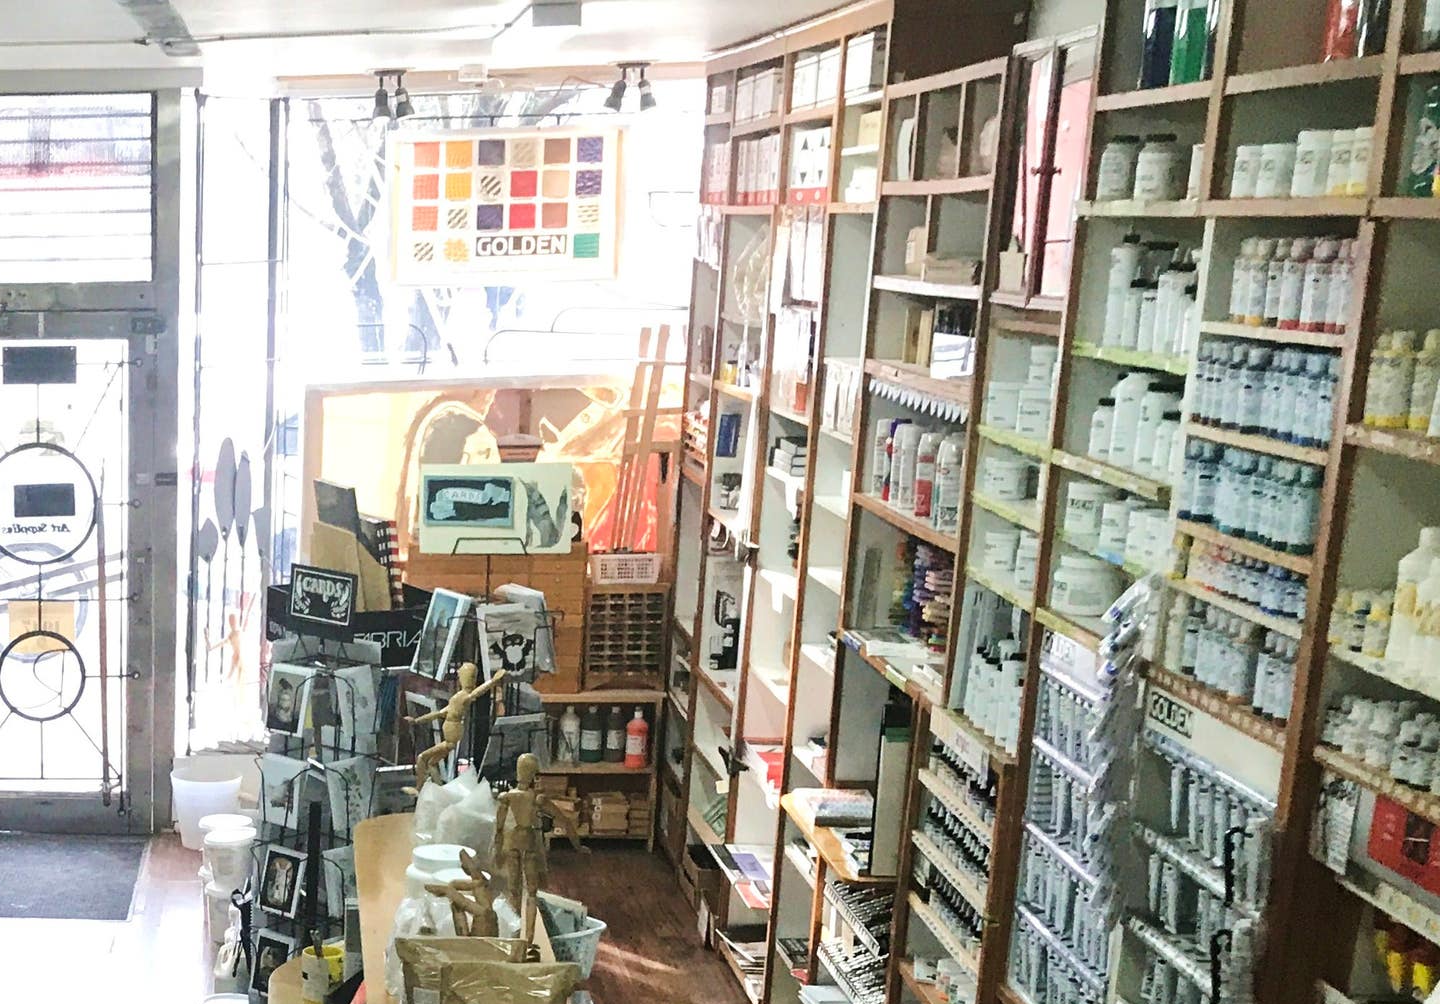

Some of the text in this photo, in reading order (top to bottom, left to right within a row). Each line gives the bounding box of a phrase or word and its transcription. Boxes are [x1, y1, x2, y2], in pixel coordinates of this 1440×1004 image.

[477, 235, 566, 256] GOLDEN
[302, 577, 344, 603] CARDS
[1150, 691, 1194, 739] GOLDEN
